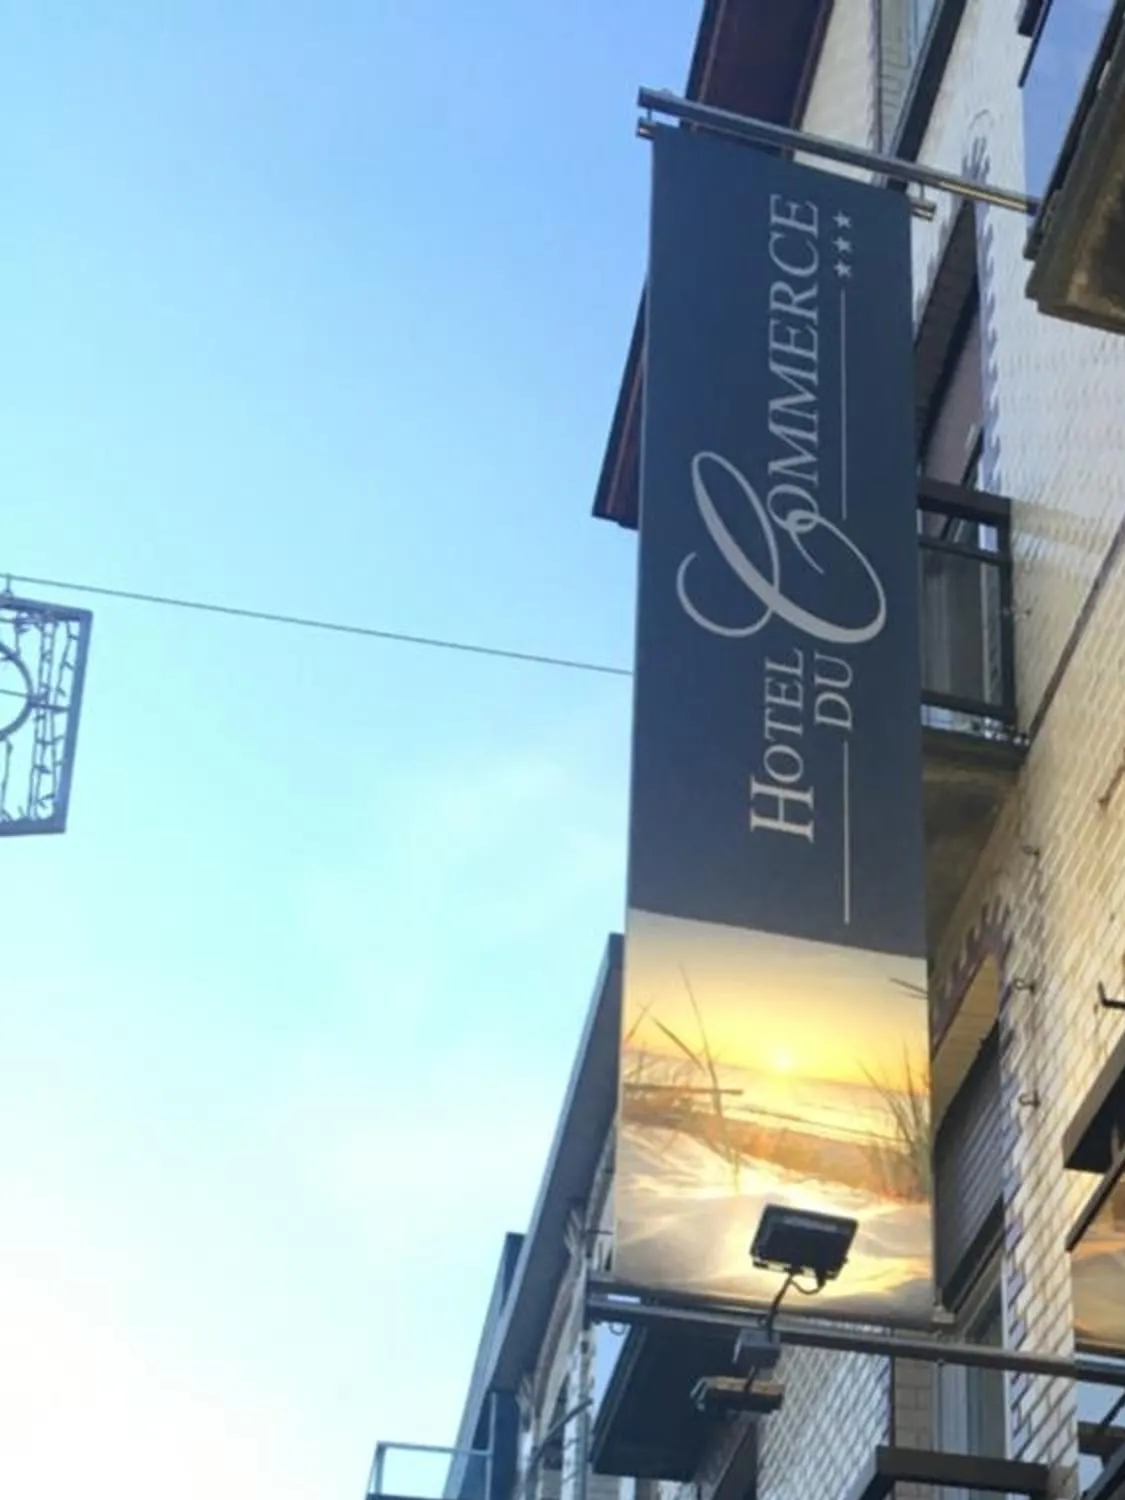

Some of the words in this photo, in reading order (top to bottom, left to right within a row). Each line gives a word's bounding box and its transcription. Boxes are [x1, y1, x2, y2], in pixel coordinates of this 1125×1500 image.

[676, 192, 888, 645] COMMERCE
[749, 648, 815, 844] HOTEL
[813, 651, 855, 732] DU
